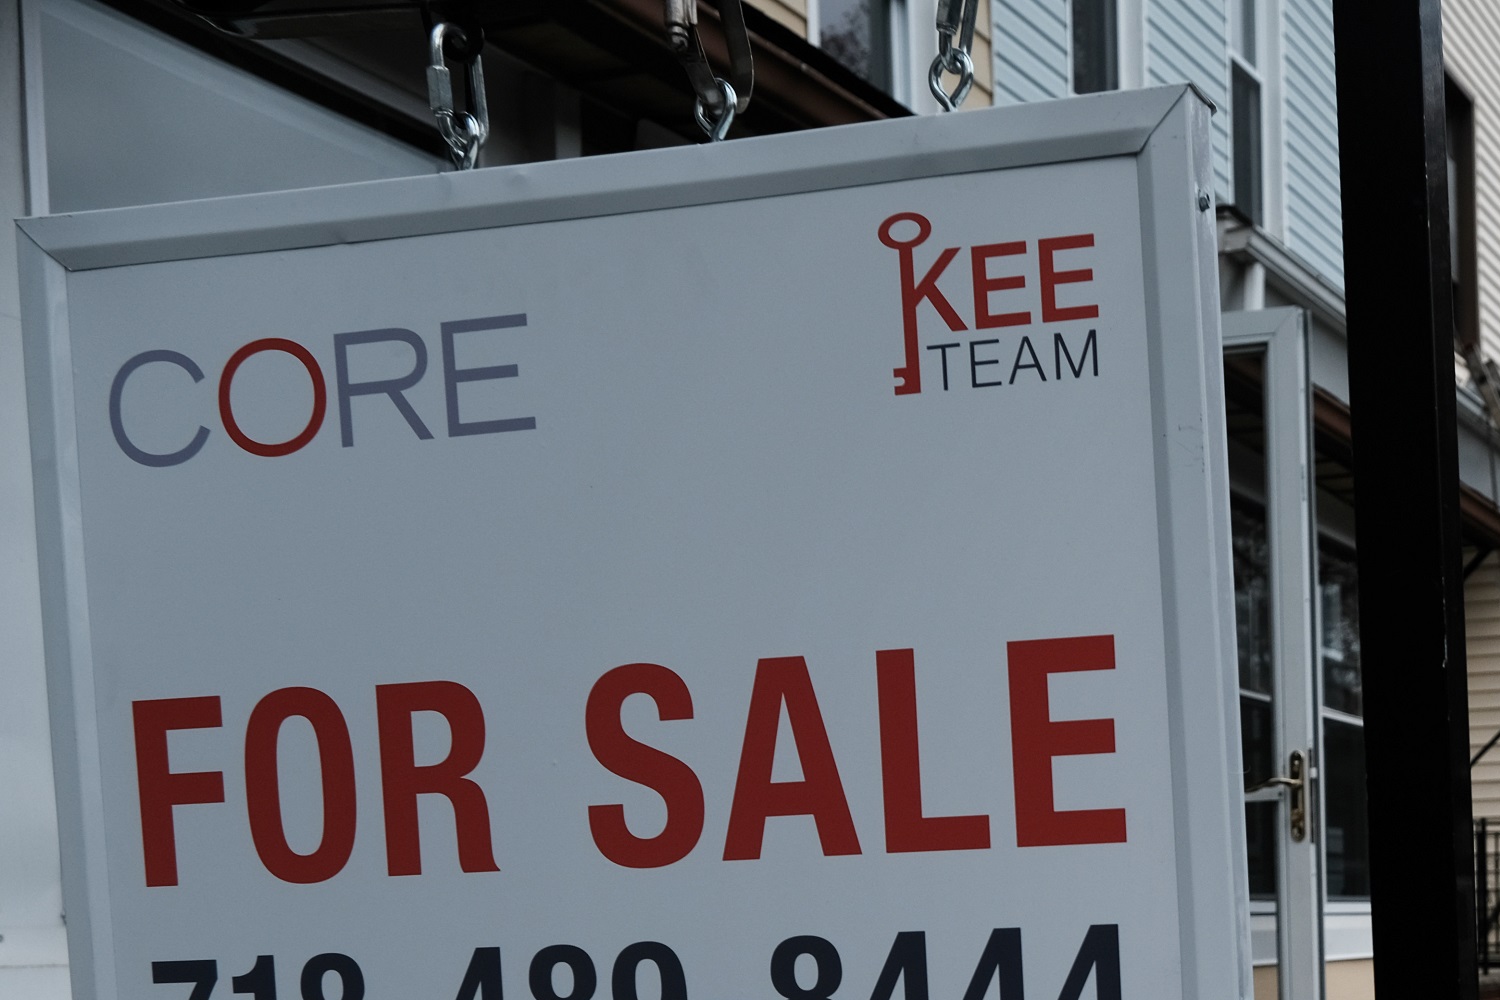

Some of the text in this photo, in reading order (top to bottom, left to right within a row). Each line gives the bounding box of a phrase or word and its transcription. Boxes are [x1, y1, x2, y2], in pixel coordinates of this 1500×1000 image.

[878, 212, 1099, 338] KEE
[109, 313, 536, 467] CORE
[926, 329, 1099, 391] TEAM
[132, 634, 1127, 887] FOR SALE
